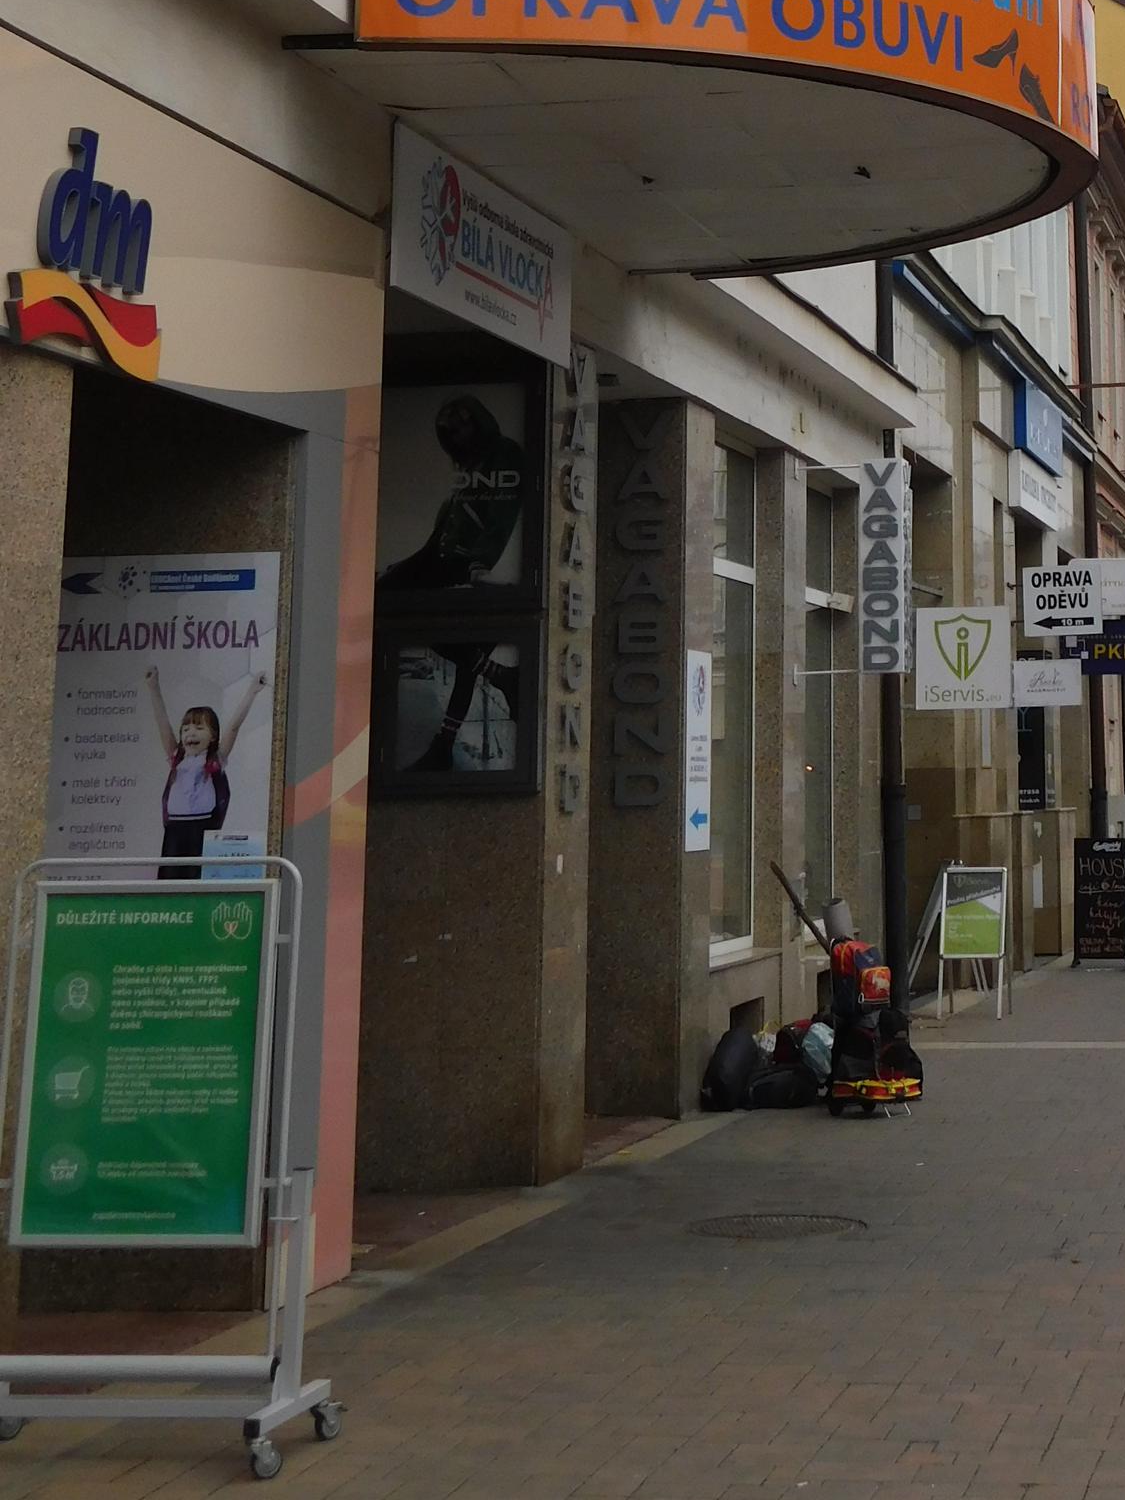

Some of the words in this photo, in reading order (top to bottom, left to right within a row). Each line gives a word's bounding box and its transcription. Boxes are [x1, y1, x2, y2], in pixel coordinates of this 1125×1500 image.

[37, 127, 153, 296] dm
[461, 217, 495, 273] BÍLÁ
[499, 240, 554, 310] VLOČKA
[862, 461, 899, 671] VAGABOND
[1031, 570, 1093, 588] OPRAVA
[612, 409, 676, 808] VAGABOND
[1036, 587, 1089, 610] ODĚVŮ
[57, 616, 179, 653] ZÁKLADNÍ
[183, 615, 260, 650] ŠKOLA
[1061, 619, 1073, 627] 10
[56, 909, 117, 925] DŮLEŽITÉ
[119, 910, 194, 925] INFORMACE
